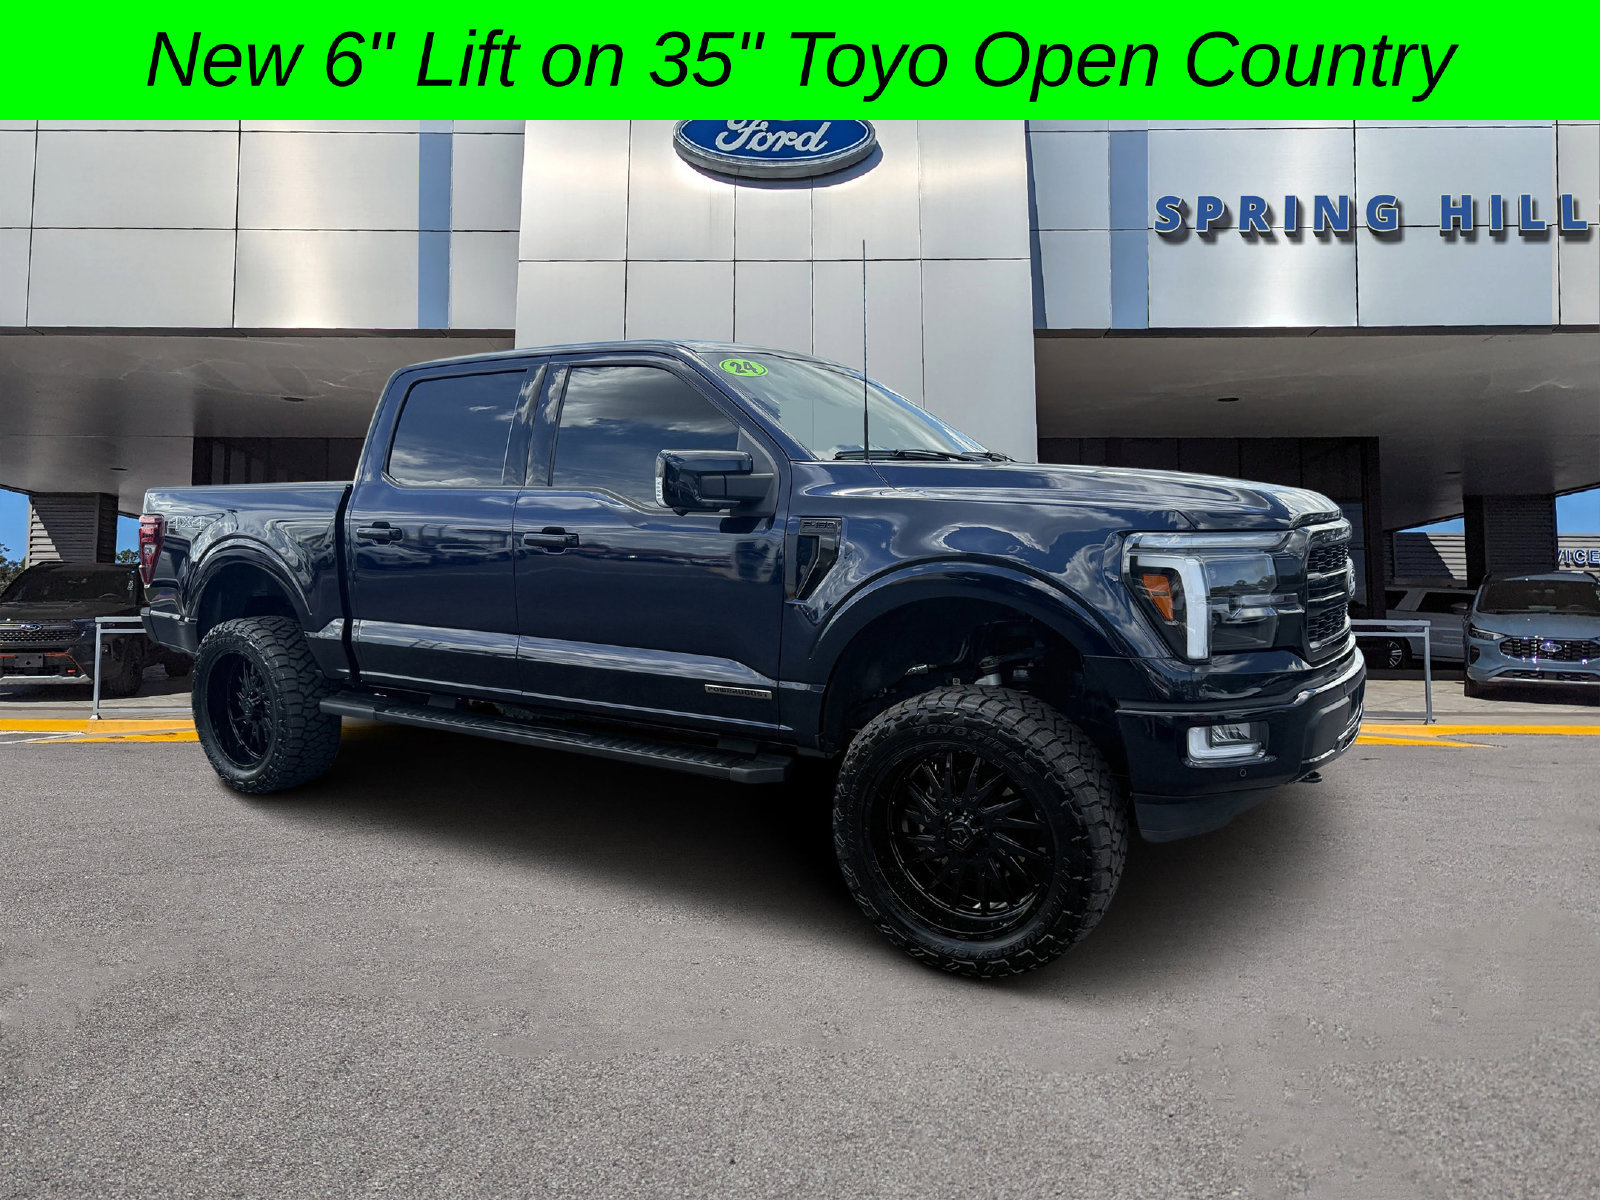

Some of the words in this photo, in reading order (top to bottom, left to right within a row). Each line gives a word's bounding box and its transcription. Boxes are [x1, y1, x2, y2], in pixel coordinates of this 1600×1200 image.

[715, 119, 832, 152] Ford
[1153, 193, 1400, 236] SPRING
[1439, 193, 1589, 234] HILL
[730, 361, 758, 373] 24
